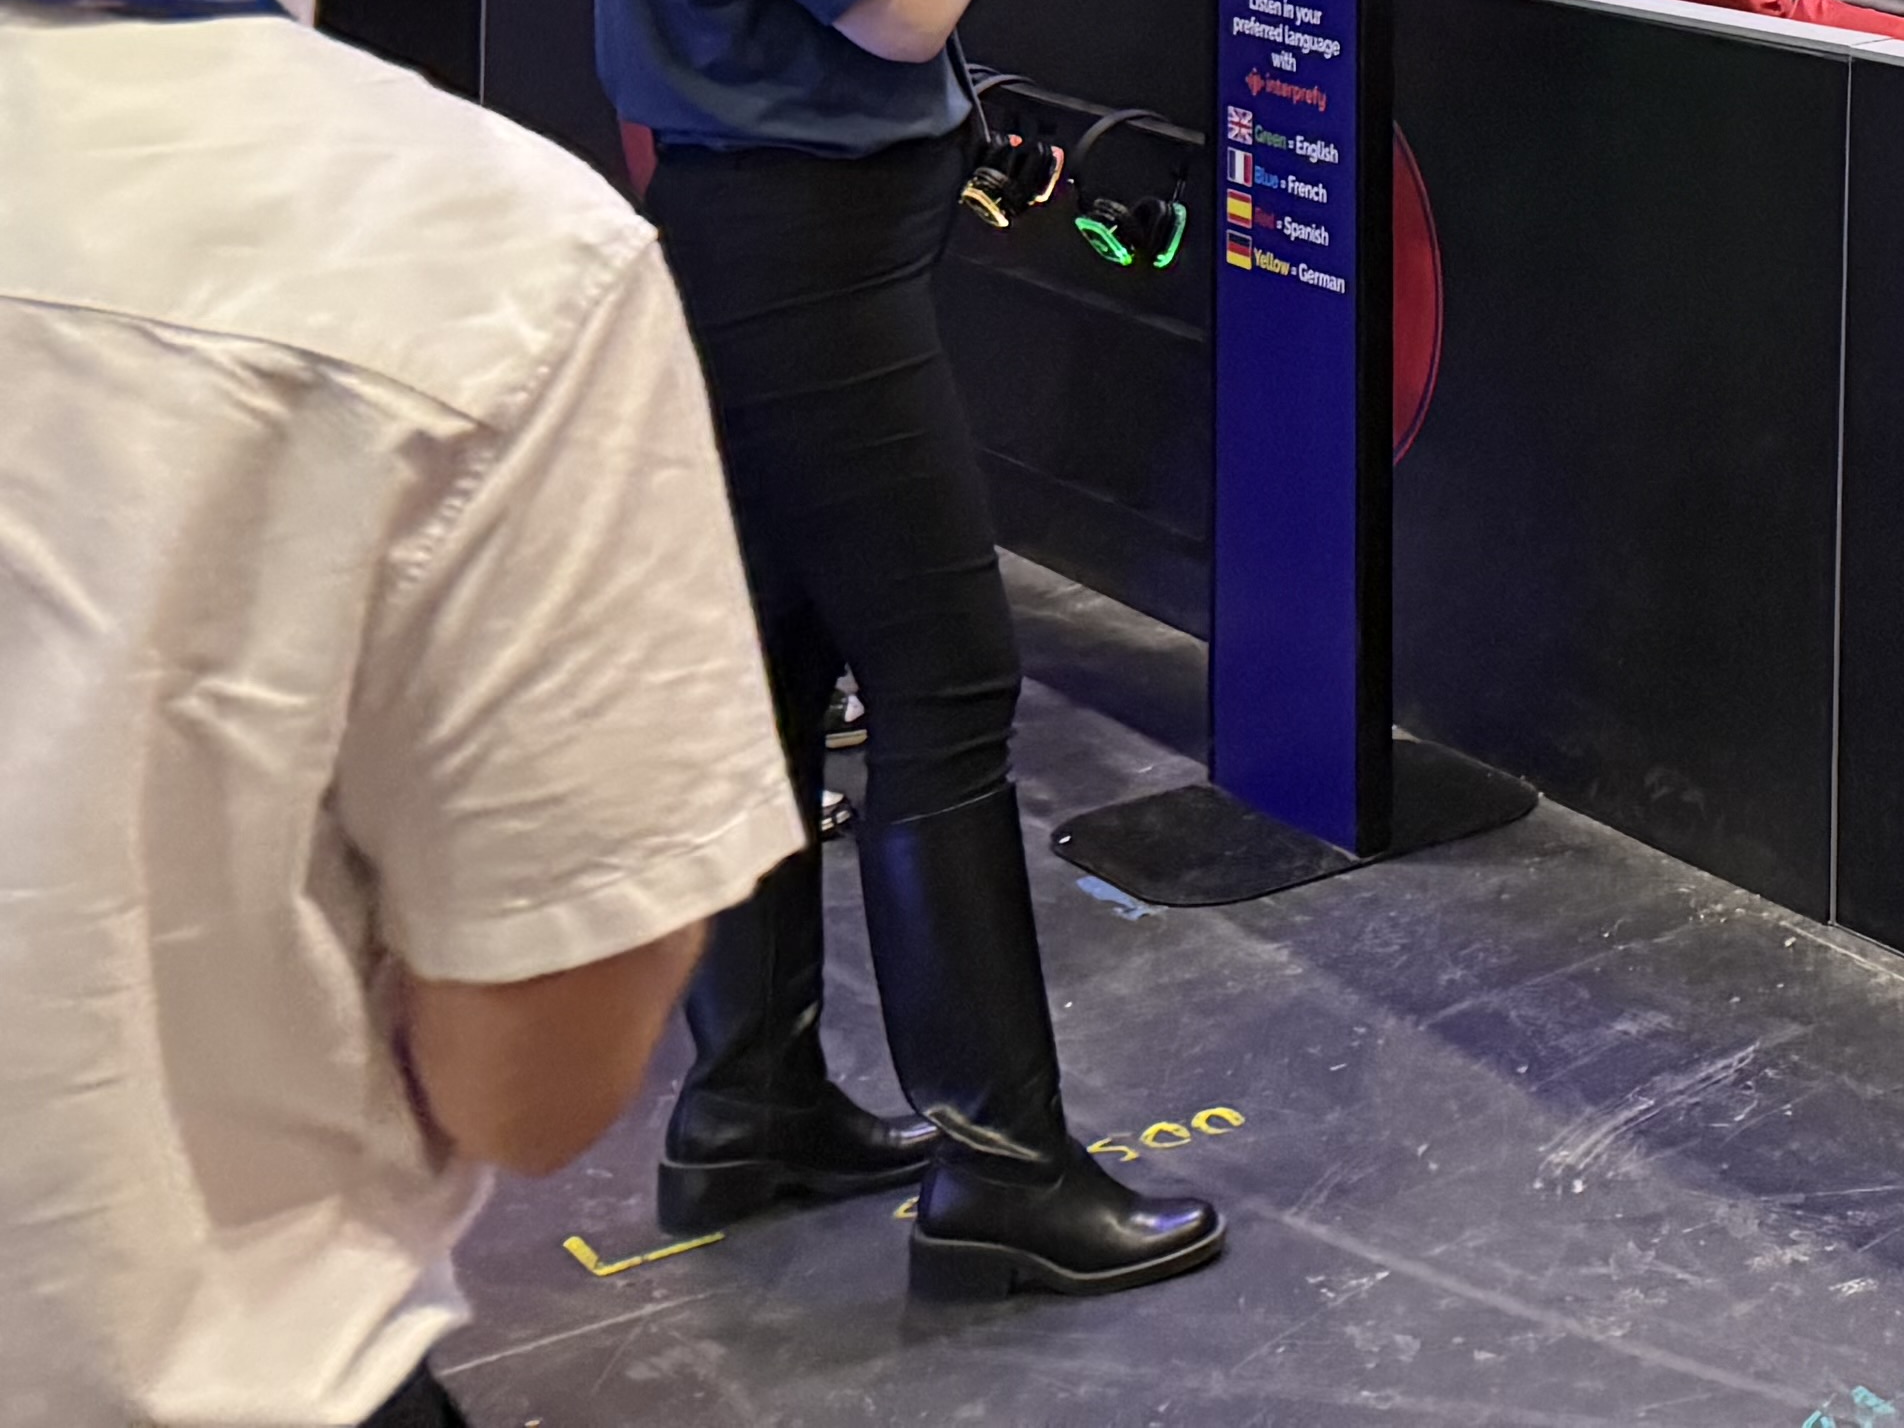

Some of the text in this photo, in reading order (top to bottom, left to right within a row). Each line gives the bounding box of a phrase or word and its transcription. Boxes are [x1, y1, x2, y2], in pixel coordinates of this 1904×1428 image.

[1296, 5, 1322, 26] your
[1232, 15, 1341, 59] preferred language
[1271, 50, 1296, 73] with
[1265, 73, 1327, 112] interprefy
[1254, 125, 1287, 150] Green
[1295, 135, 1339, 164] English
[1254, 165, 1279, 190] Blue
[1287, 176, 1327, 204] French
[1283, 216, 1330, 247] Spanish
[1254, 247, 1290, 276] Yellow
[1298, 263, 1346, 294] German
